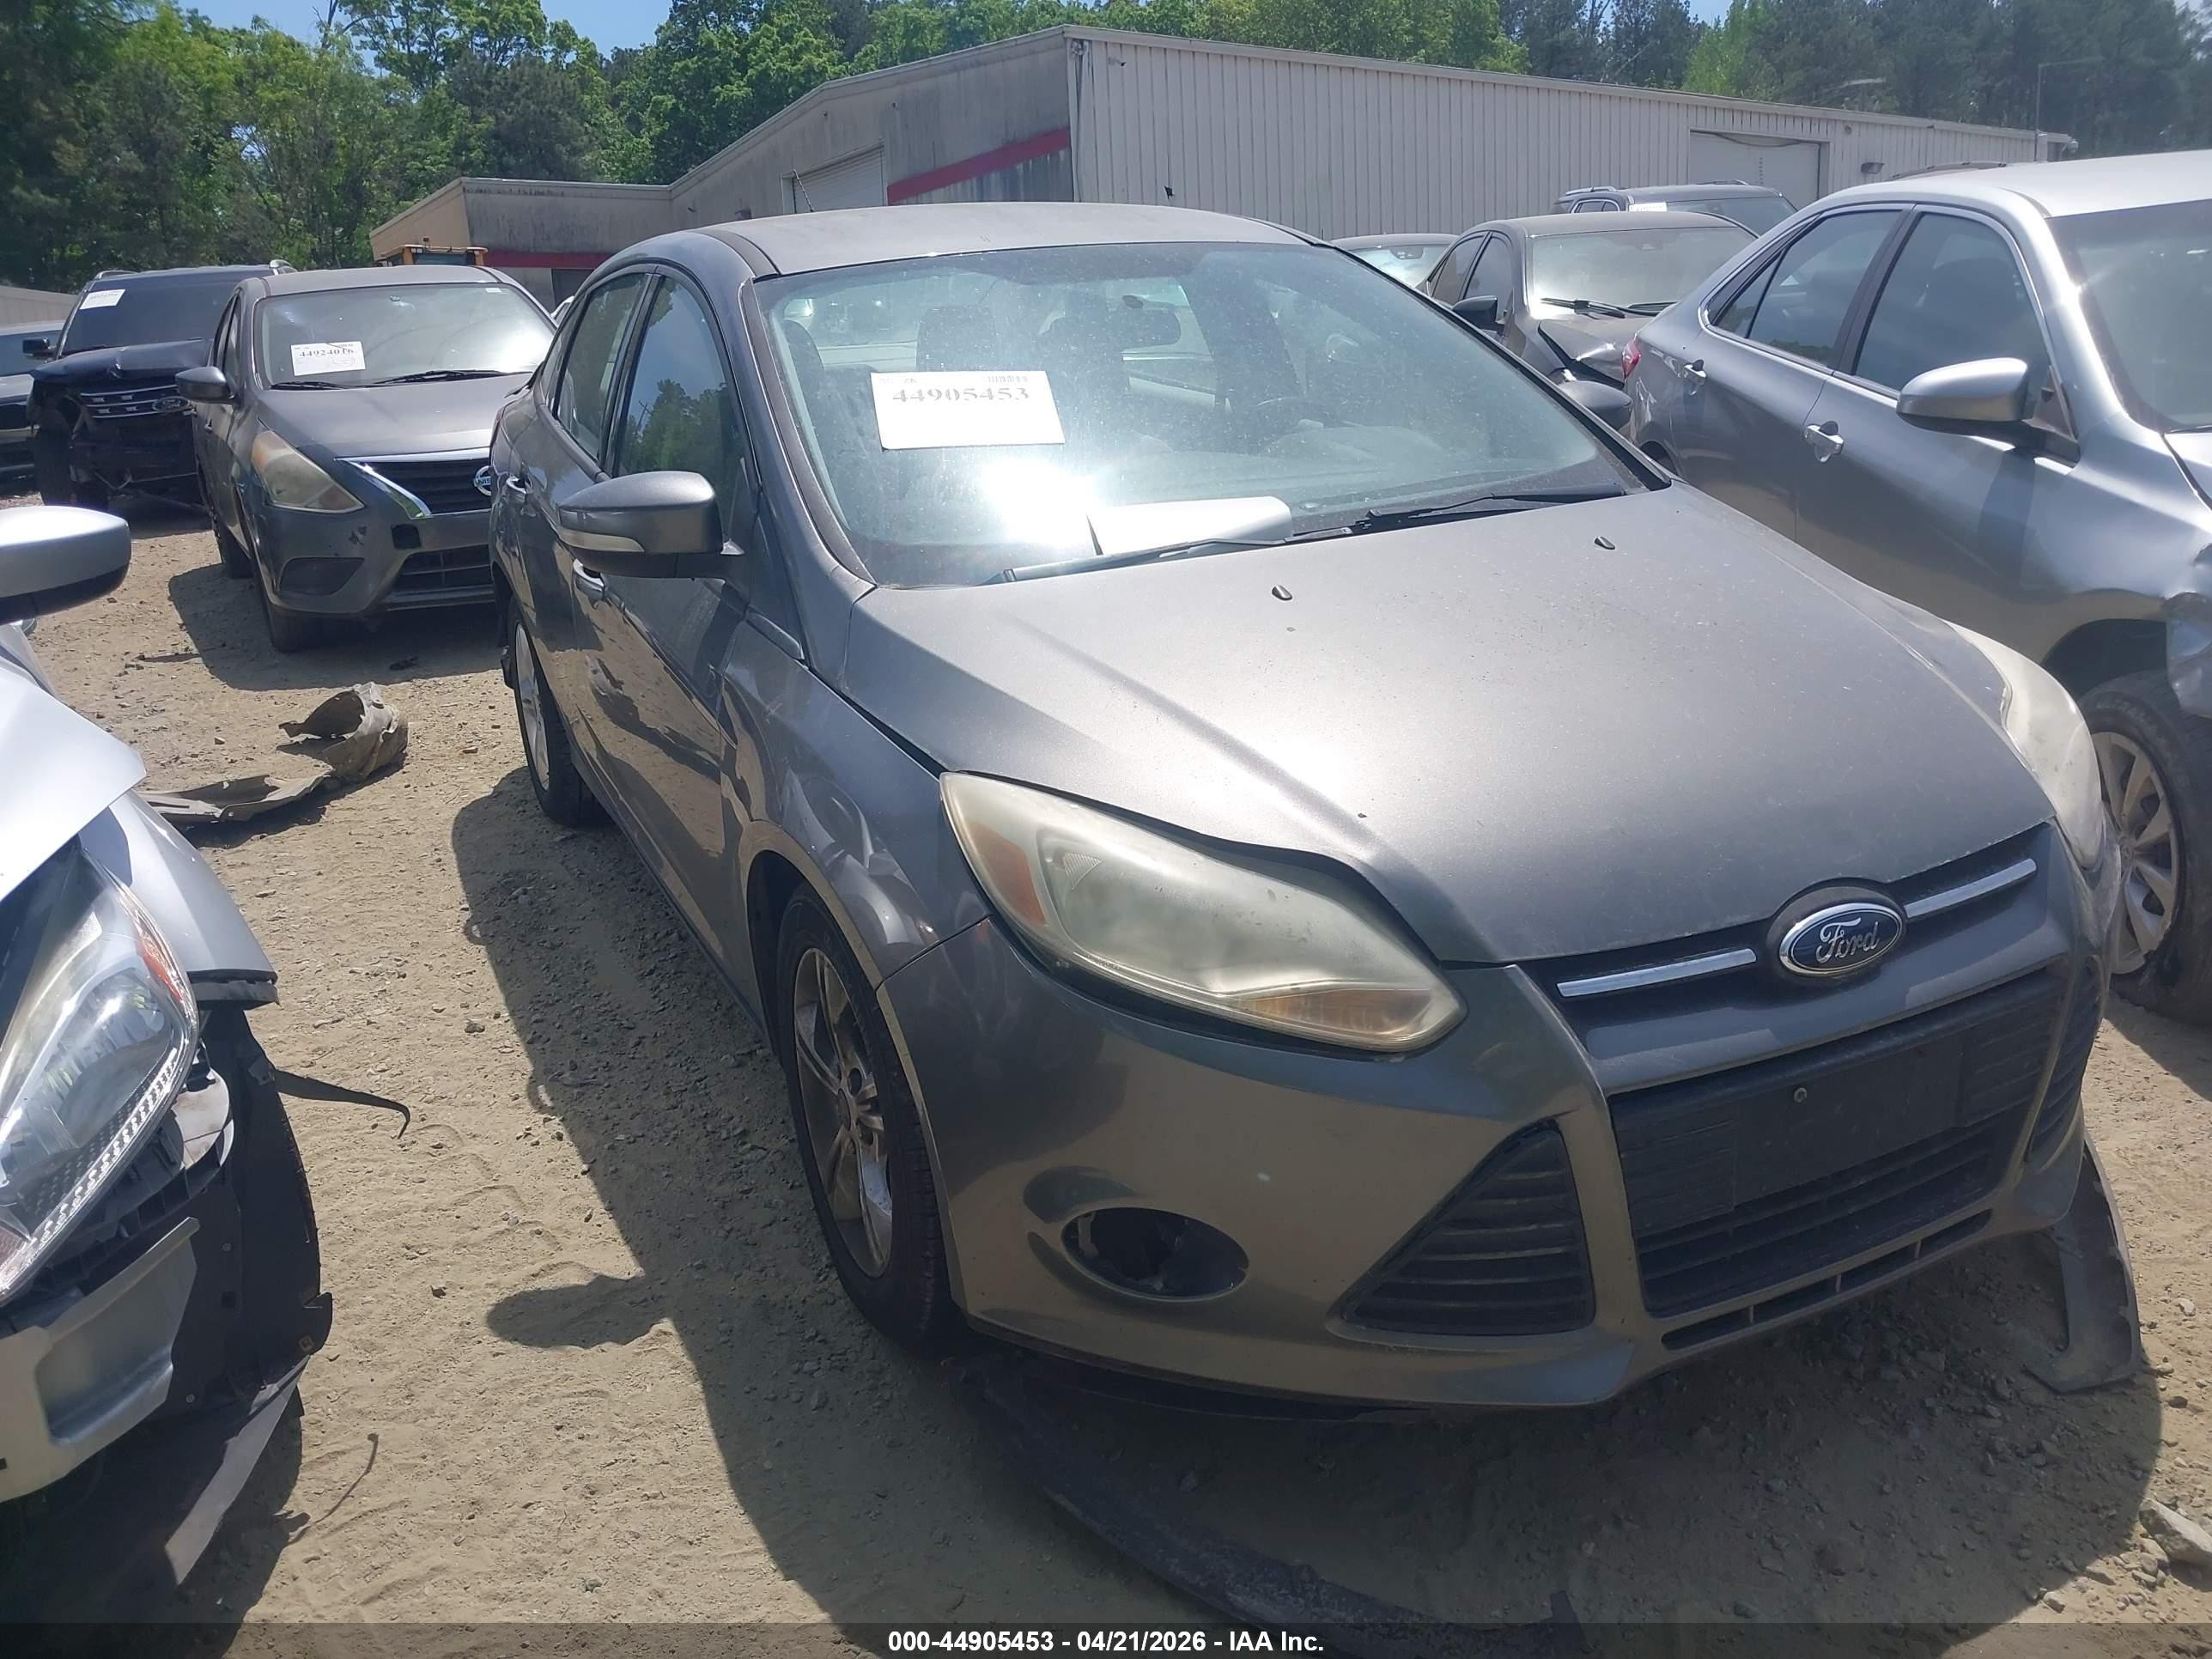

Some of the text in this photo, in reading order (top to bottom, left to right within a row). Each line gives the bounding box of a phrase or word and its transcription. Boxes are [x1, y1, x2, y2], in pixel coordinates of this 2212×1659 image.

[299, 348, 354, 357] 44924016
[892, 386, 1030, 403] 44905453
[1815, 916, 1881, 963] Ford
